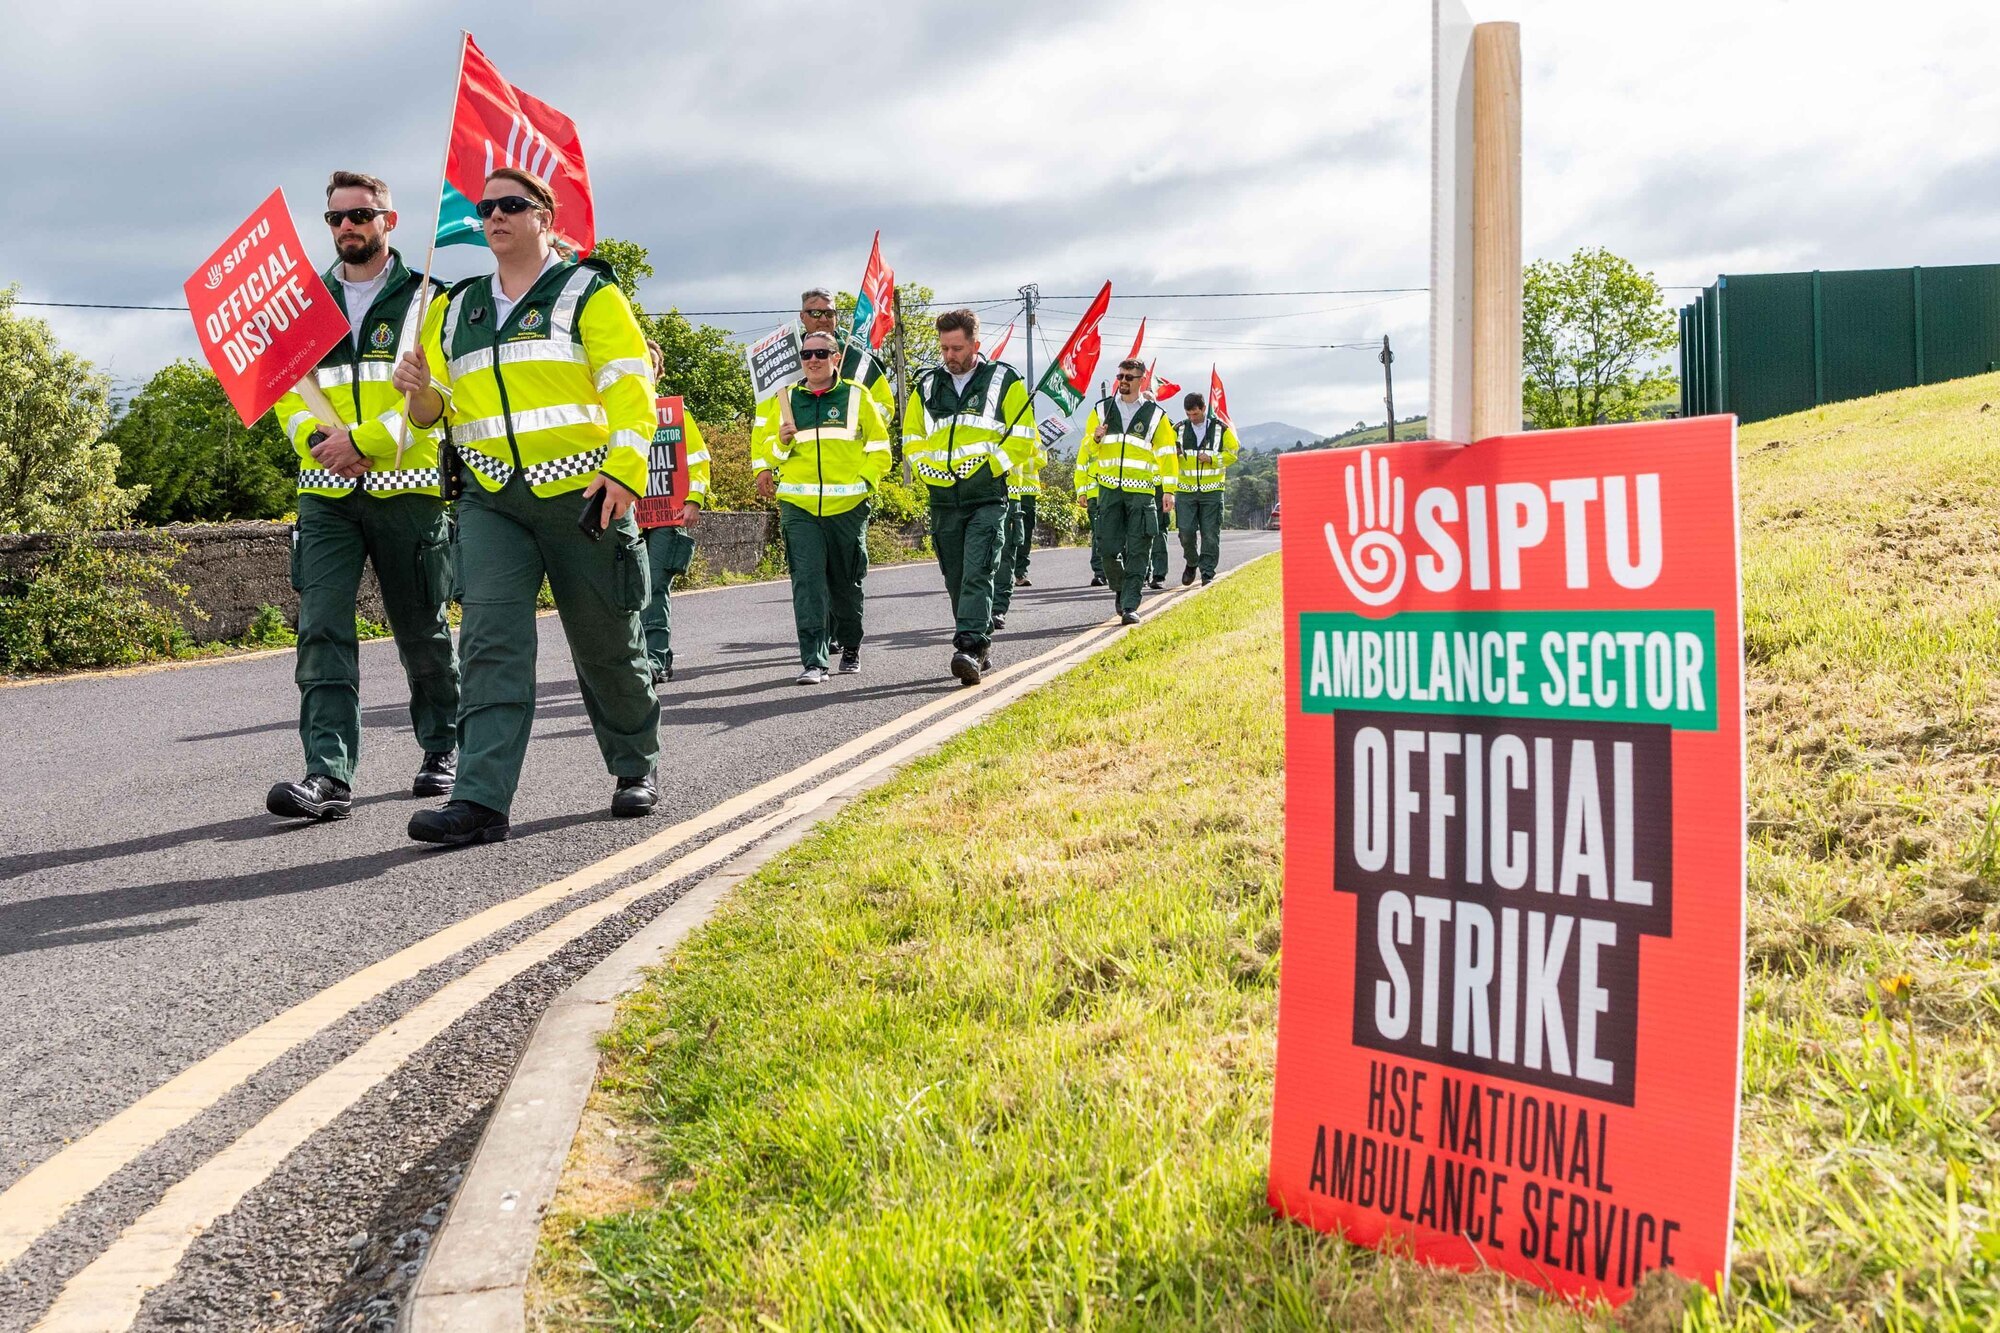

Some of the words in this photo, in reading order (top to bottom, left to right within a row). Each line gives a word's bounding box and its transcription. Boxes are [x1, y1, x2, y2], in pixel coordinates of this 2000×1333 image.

[205, 243, 298, 344] OFFICIAL
[224, 217, 270, 274] SIPTU
[221, 275, 313, 376] DISPUTE
[266, 339, 316, 388] www.siptu.ie
[756, 339, 788, 364] Stailc
[764, 360, 797, 387] Anseo
[1414, 473, 1663, 592] SIPTU
[1309, 630, 1529, 704] AMBULANCE
[1540, 630, 1706, 711] SECTOR
[1353, 726, 1653, 906] OFFICIAL
[1374, 890, 1618, 1086] STRIKE
[1367, 1060, 1428, 1144] HSE
[1438, 1077, 1613, 1194] NATIONAL
[1308, 1124, 1508, 1251] AMBULANCE
[1520, 1182, 1682, 1288] SERVICE
